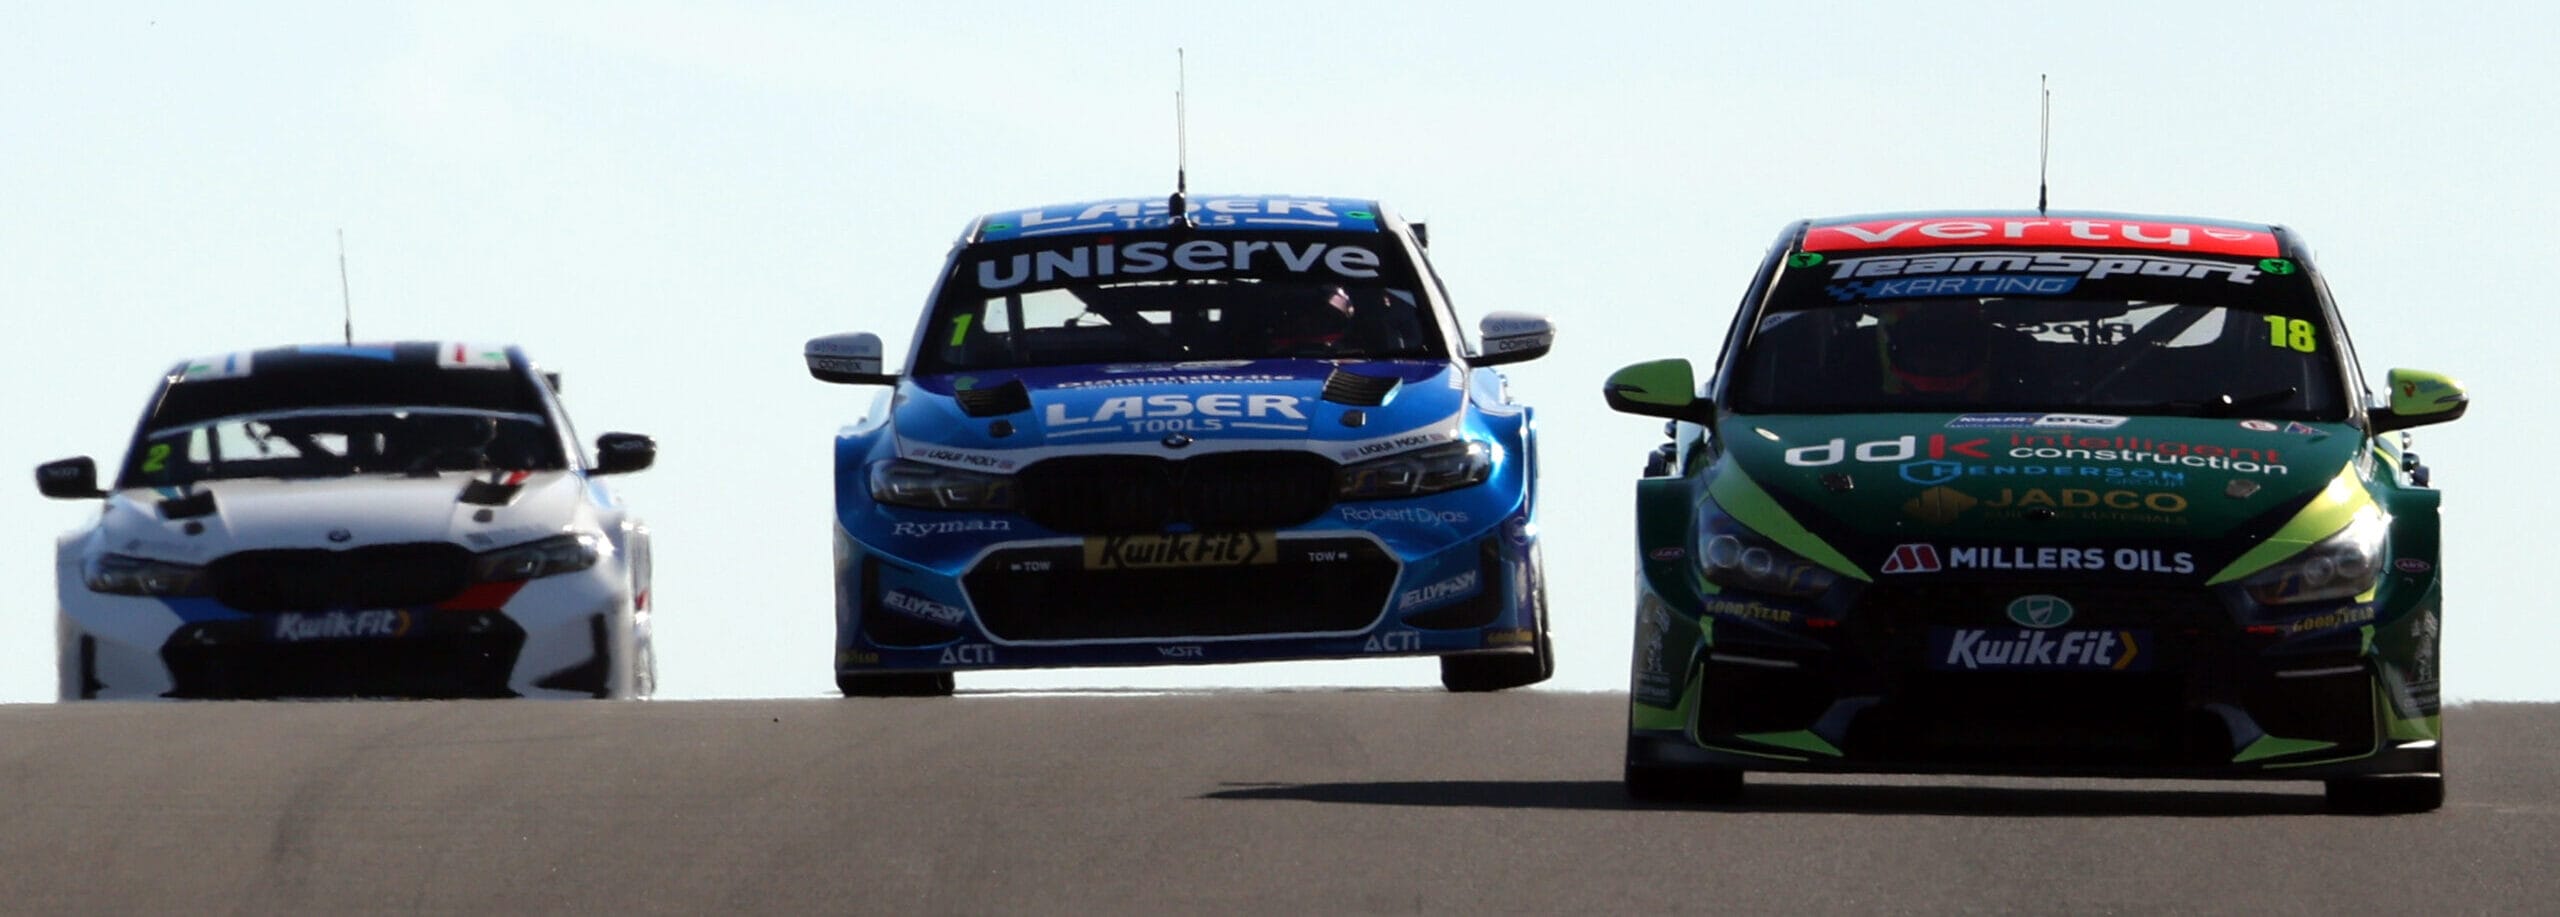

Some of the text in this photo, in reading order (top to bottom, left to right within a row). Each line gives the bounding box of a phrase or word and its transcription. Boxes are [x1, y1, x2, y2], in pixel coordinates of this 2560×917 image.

[1020, 199, 1337, 228] LASER
[1827, 250, 2262, 285] TeamSport
[1879, 277, 2067, 296] KARTING
[950, 314, 973, 347] 1
[2262, 314, 2317, 353] 18
[1046, 393, 1307, 427] LASER
[1127, 418, 1224, 434] TOOLS
[1394, 434, 1428, 449] MOLY
[1784, 434, 1992, 467] ddk
[2009, 432, 2280, 464] intelligent
[142, 443, 169, 472] 2
[964, 453, 999, 467] MOLY
[2009, 447, 2289, 475] construction
[1932, 464, 2185, 481] HENDERSON
[1984, 487, 2188, 513] JADCO
[892, 519, 1011, 538] Ryman
[1342, 506, 1469, 526] Robert Dyas
[1023, 561, 1050, 571] TOW
[1309, 551, 1336, 562] TOW
[1949, 546, 2195, 574] MILLERS OILS
